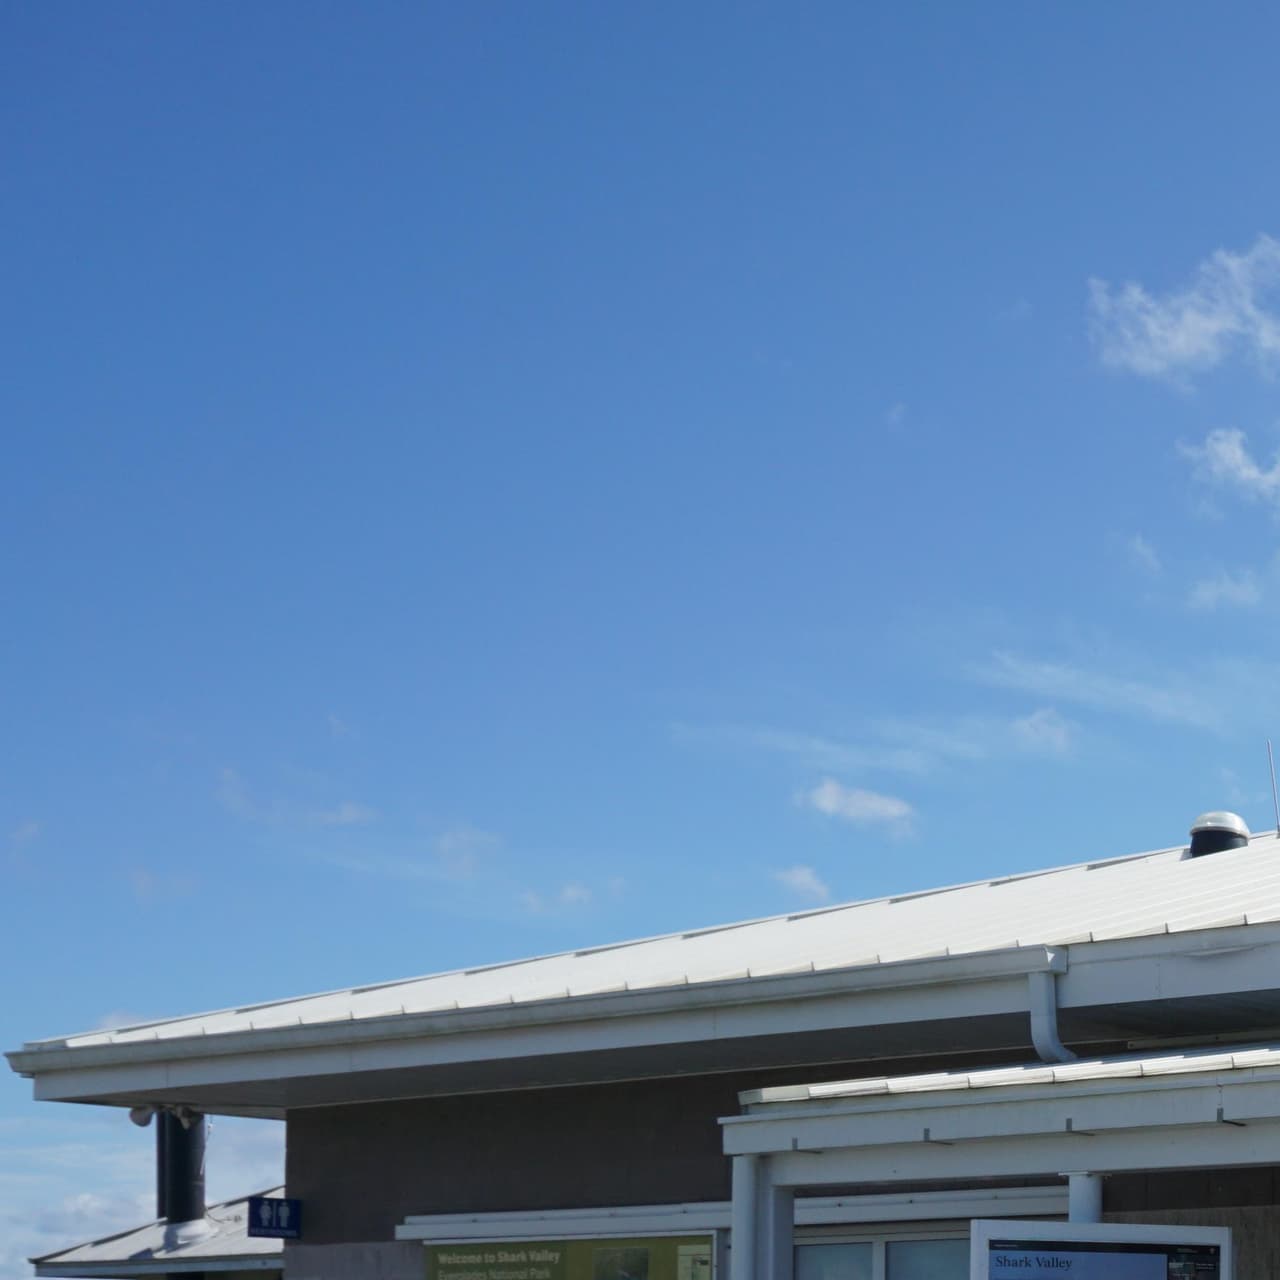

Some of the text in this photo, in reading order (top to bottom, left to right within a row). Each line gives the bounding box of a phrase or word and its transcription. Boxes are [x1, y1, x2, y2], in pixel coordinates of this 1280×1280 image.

[438, 1249, 561, 1265] Welcome to Shark Valley
[995, 1255, 1073, 1271] Shark Valley
[529, 1266, 552, 1279] Park
